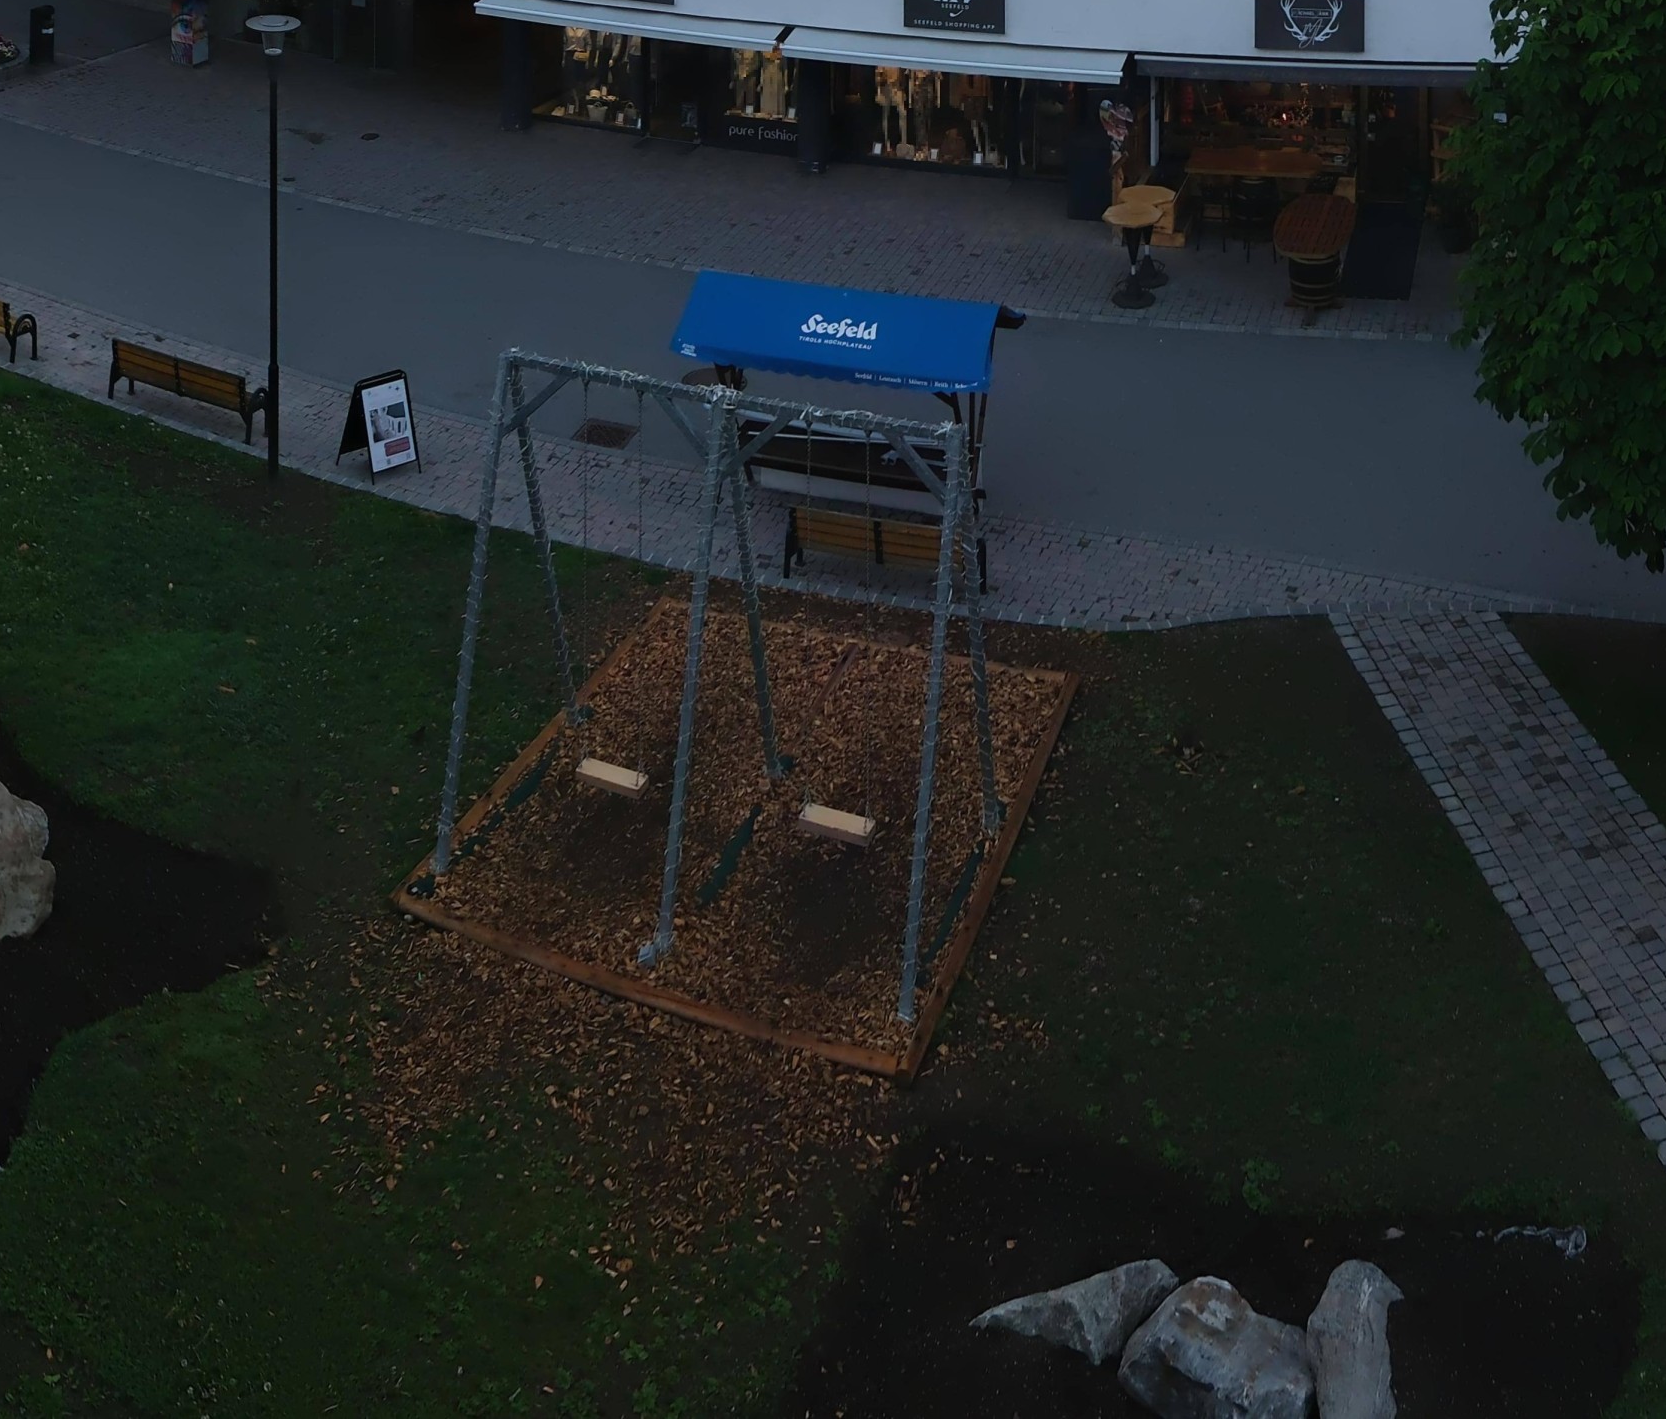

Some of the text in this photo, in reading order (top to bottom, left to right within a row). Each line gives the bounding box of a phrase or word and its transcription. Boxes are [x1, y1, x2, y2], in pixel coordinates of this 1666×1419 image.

[945, 21, 980, 29] SHOPPING
[729, 125, 755, 137] pure
[801, 313, 879, 341] Seefeld
[799, 336, 873, 351] TIROLS HOCHPLATEAU
